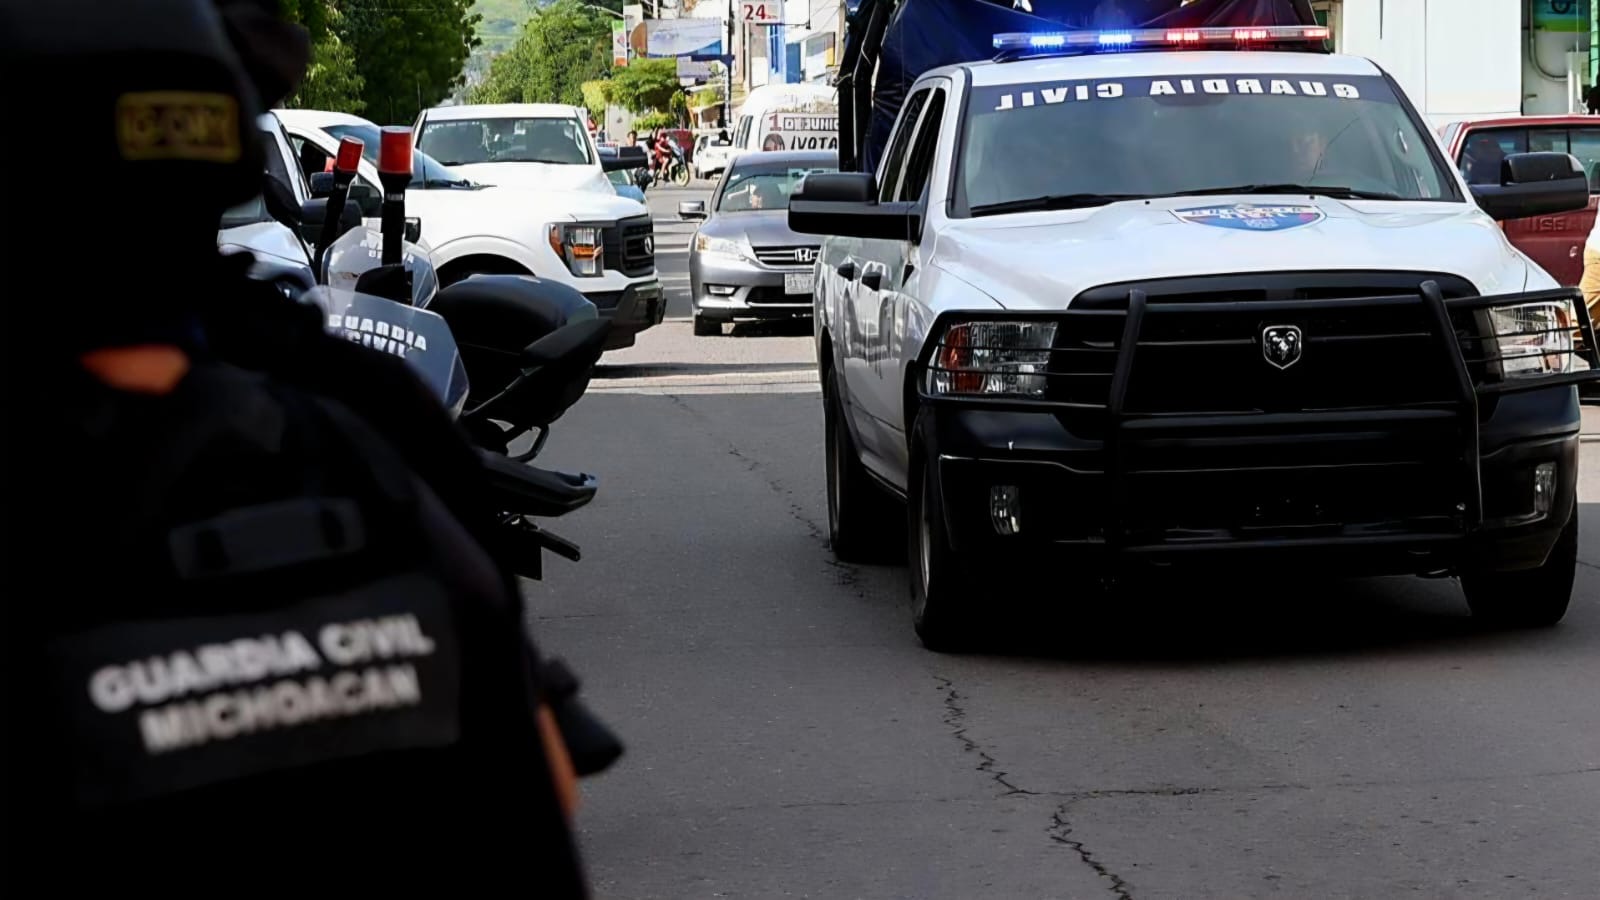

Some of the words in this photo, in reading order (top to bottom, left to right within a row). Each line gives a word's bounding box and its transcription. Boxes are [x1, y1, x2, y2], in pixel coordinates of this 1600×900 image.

[744, 4, 766, 20] 24
[328, 313, 427, 352] GUARDIA
[88, 630, 321, 713] GUARDIA
[318, 613, 436, 665] CIVIL
[138, 664, 422, 755] MICHOACAN
